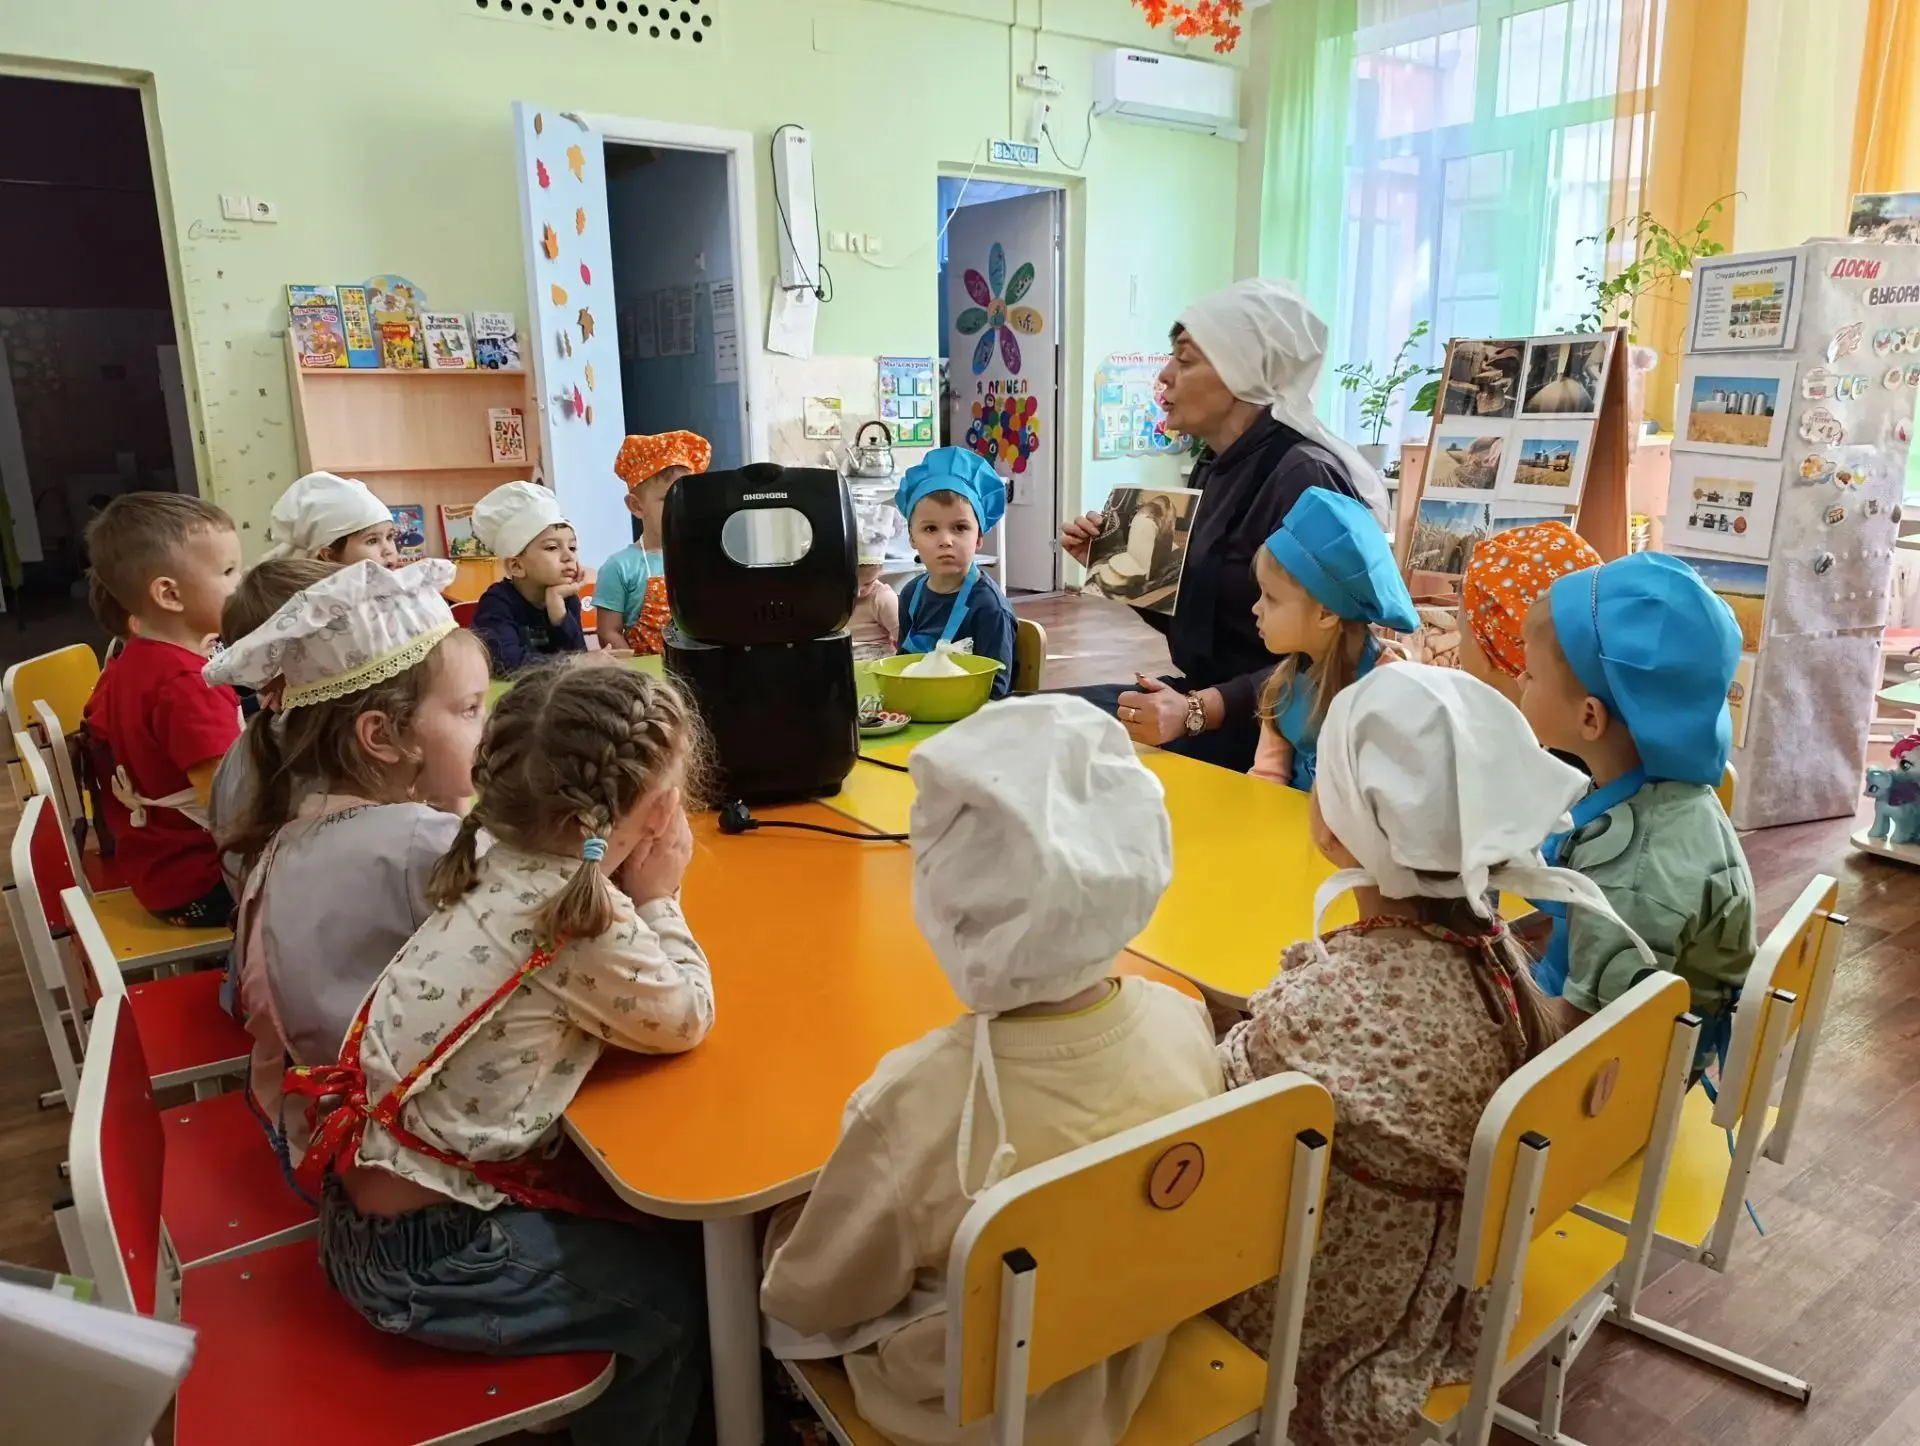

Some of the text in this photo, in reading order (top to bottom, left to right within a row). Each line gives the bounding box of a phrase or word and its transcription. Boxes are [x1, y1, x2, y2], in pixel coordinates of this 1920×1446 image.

[994, 143, 1036, 162] ВЫХОД
[1831, 258, 1881, 279] ДОСКА
[1868, 285, 1919, 306] ВЫБОРА
[976, 379, 1027, 395] Я ПРИШЕЛ
[743, 492, 788, 501] REDMOND
[1164, 1159, 1192, 1195] 1
